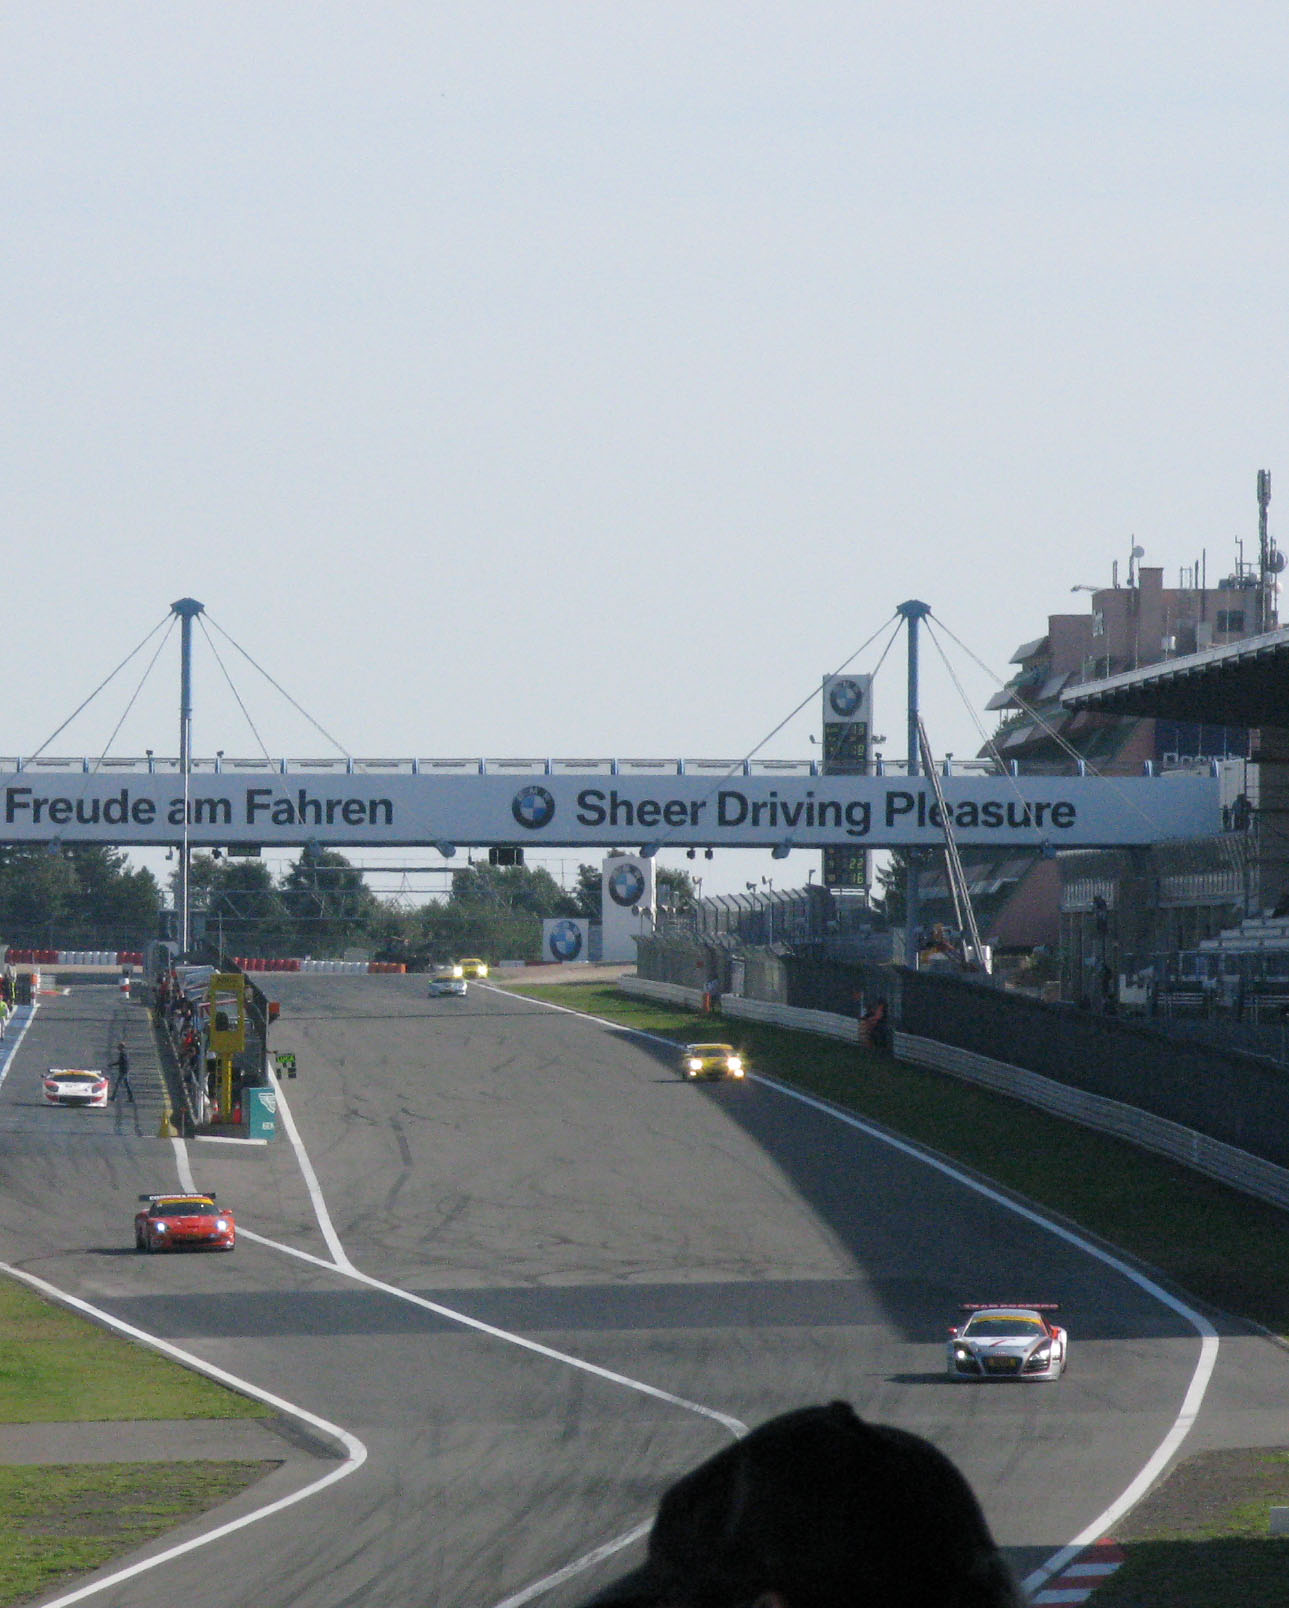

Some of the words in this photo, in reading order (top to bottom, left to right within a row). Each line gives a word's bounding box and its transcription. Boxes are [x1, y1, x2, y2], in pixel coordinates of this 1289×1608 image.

[5, 787, 156, 825] Freude
[167, 796, 232, 825] am
[246, 787, 394, 826] Fahren
[576, 789, 707, 828] Sheer
[717, 790, 872, 837] Driving
[885, 790, 1077, 829] Pleasure
